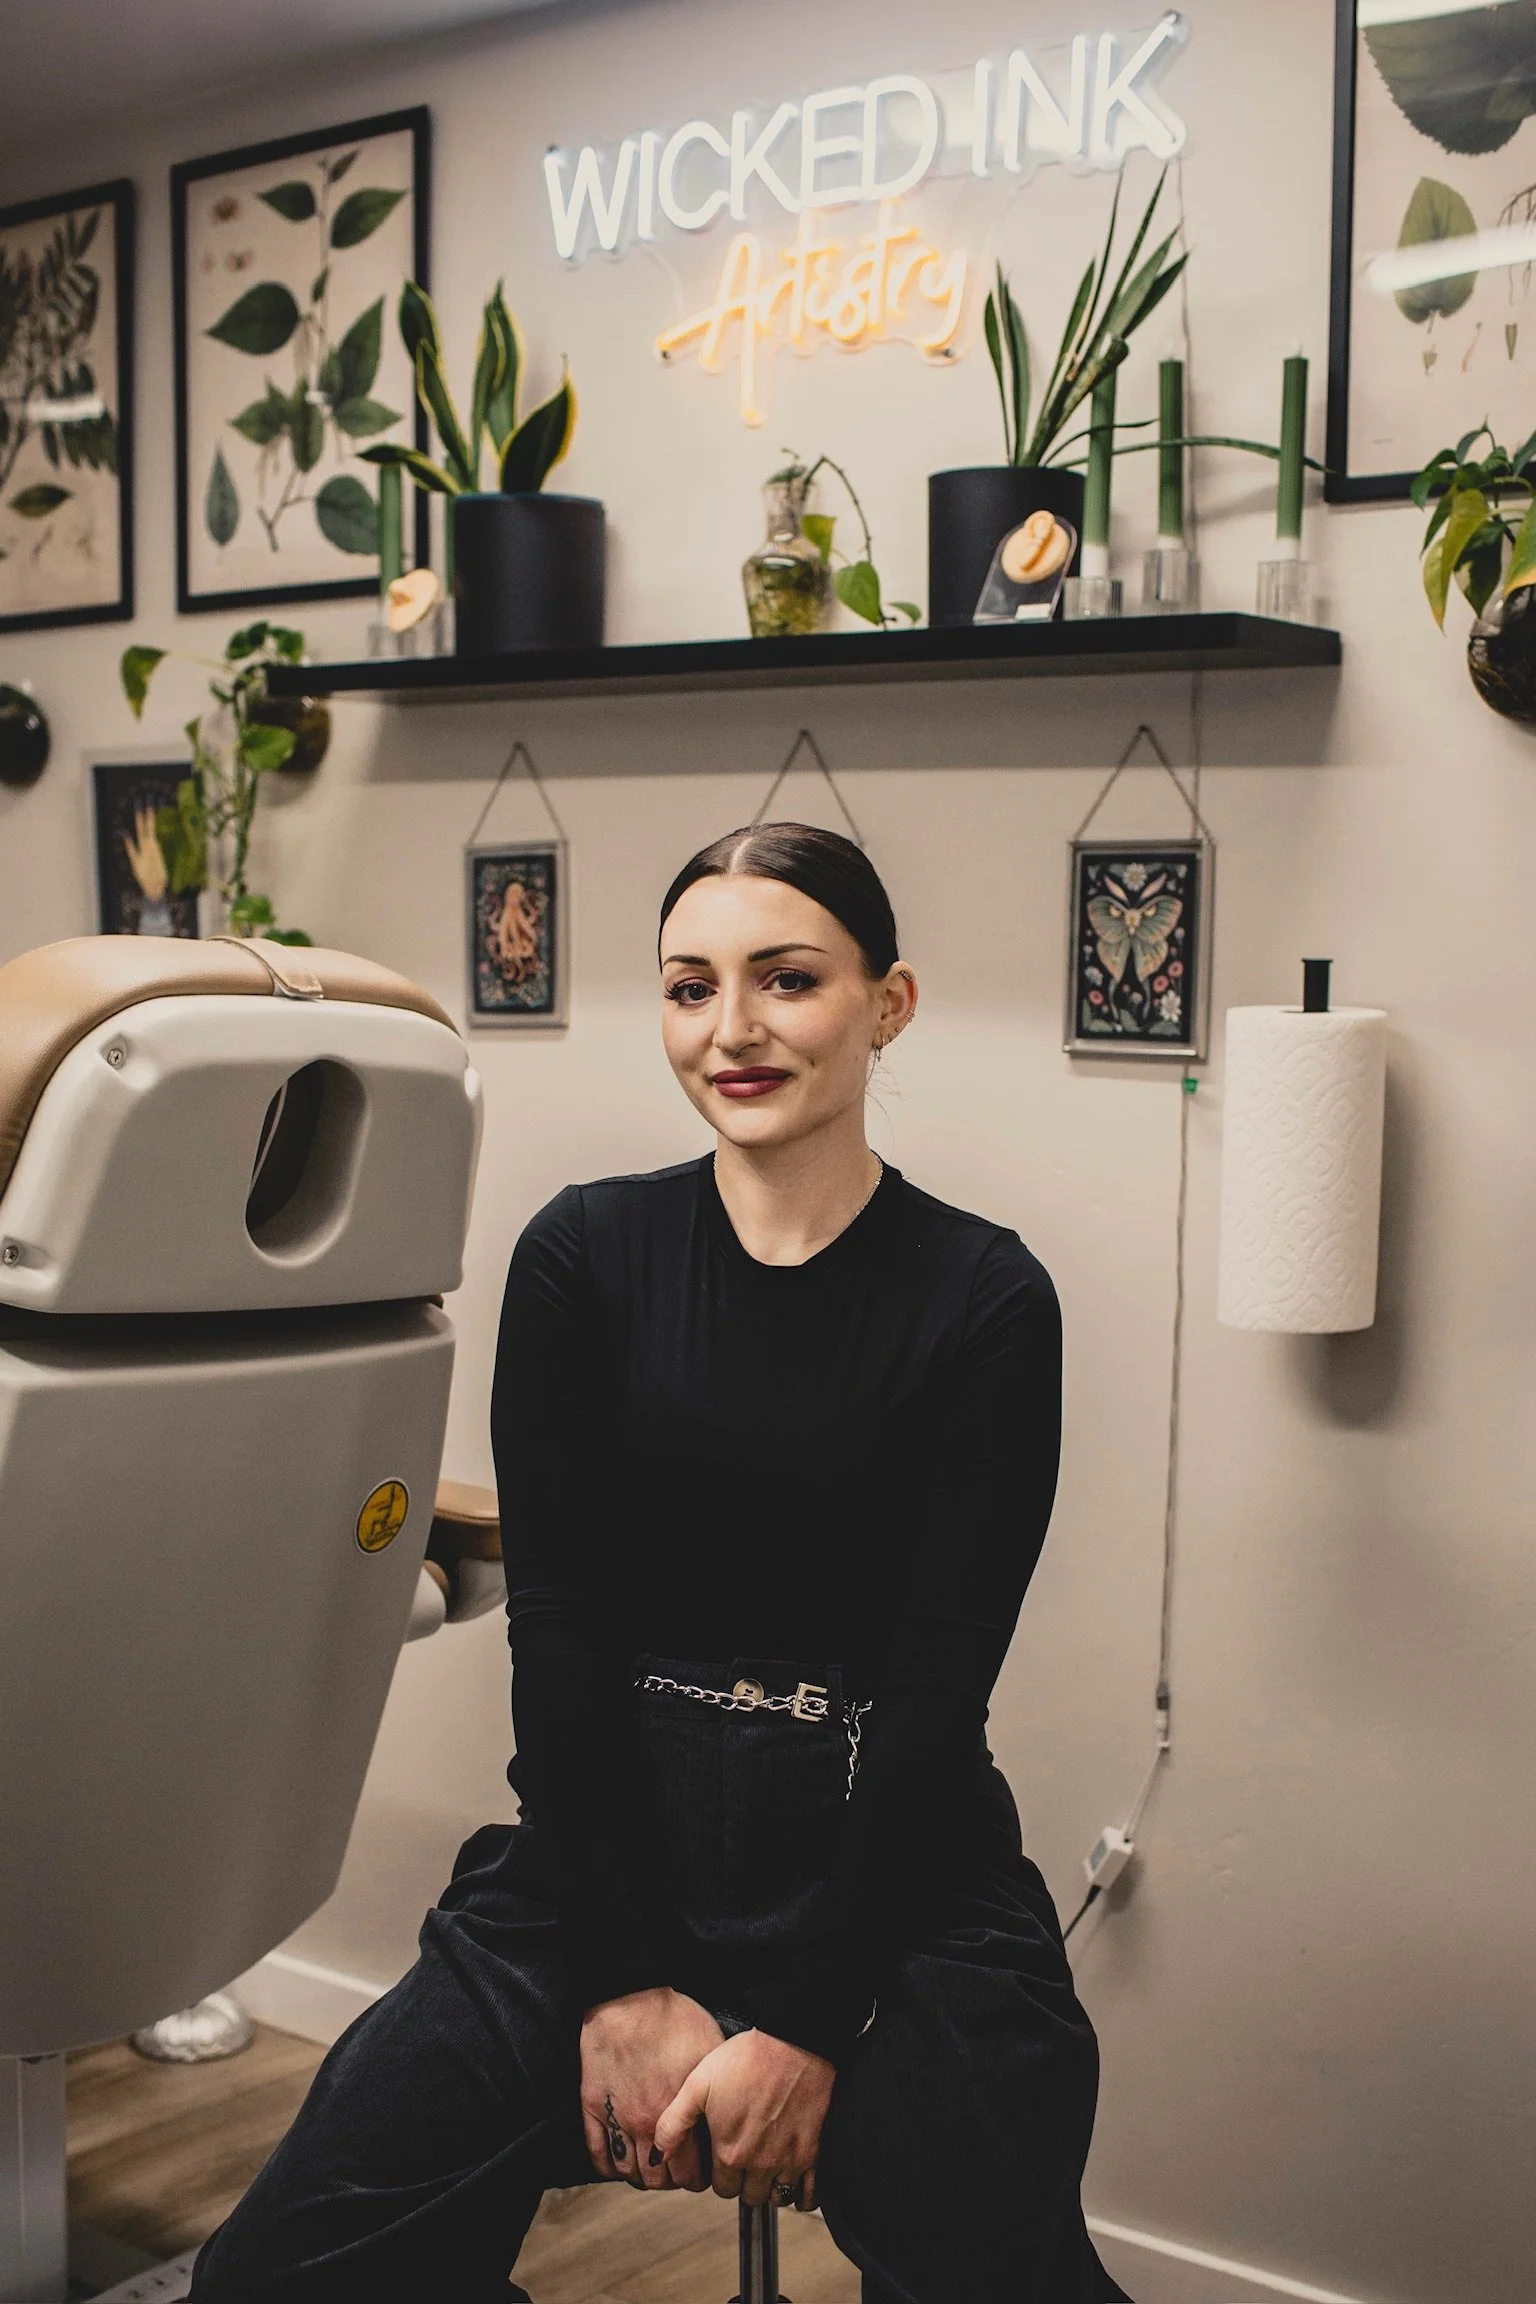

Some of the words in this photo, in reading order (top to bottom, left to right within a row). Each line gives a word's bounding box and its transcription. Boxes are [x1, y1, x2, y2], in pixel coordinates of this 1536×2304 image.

[544, 76, 940, 258] WICKED
[974, 14, 1187, 177] INK
[656, 197, 967, 425] Artistry
